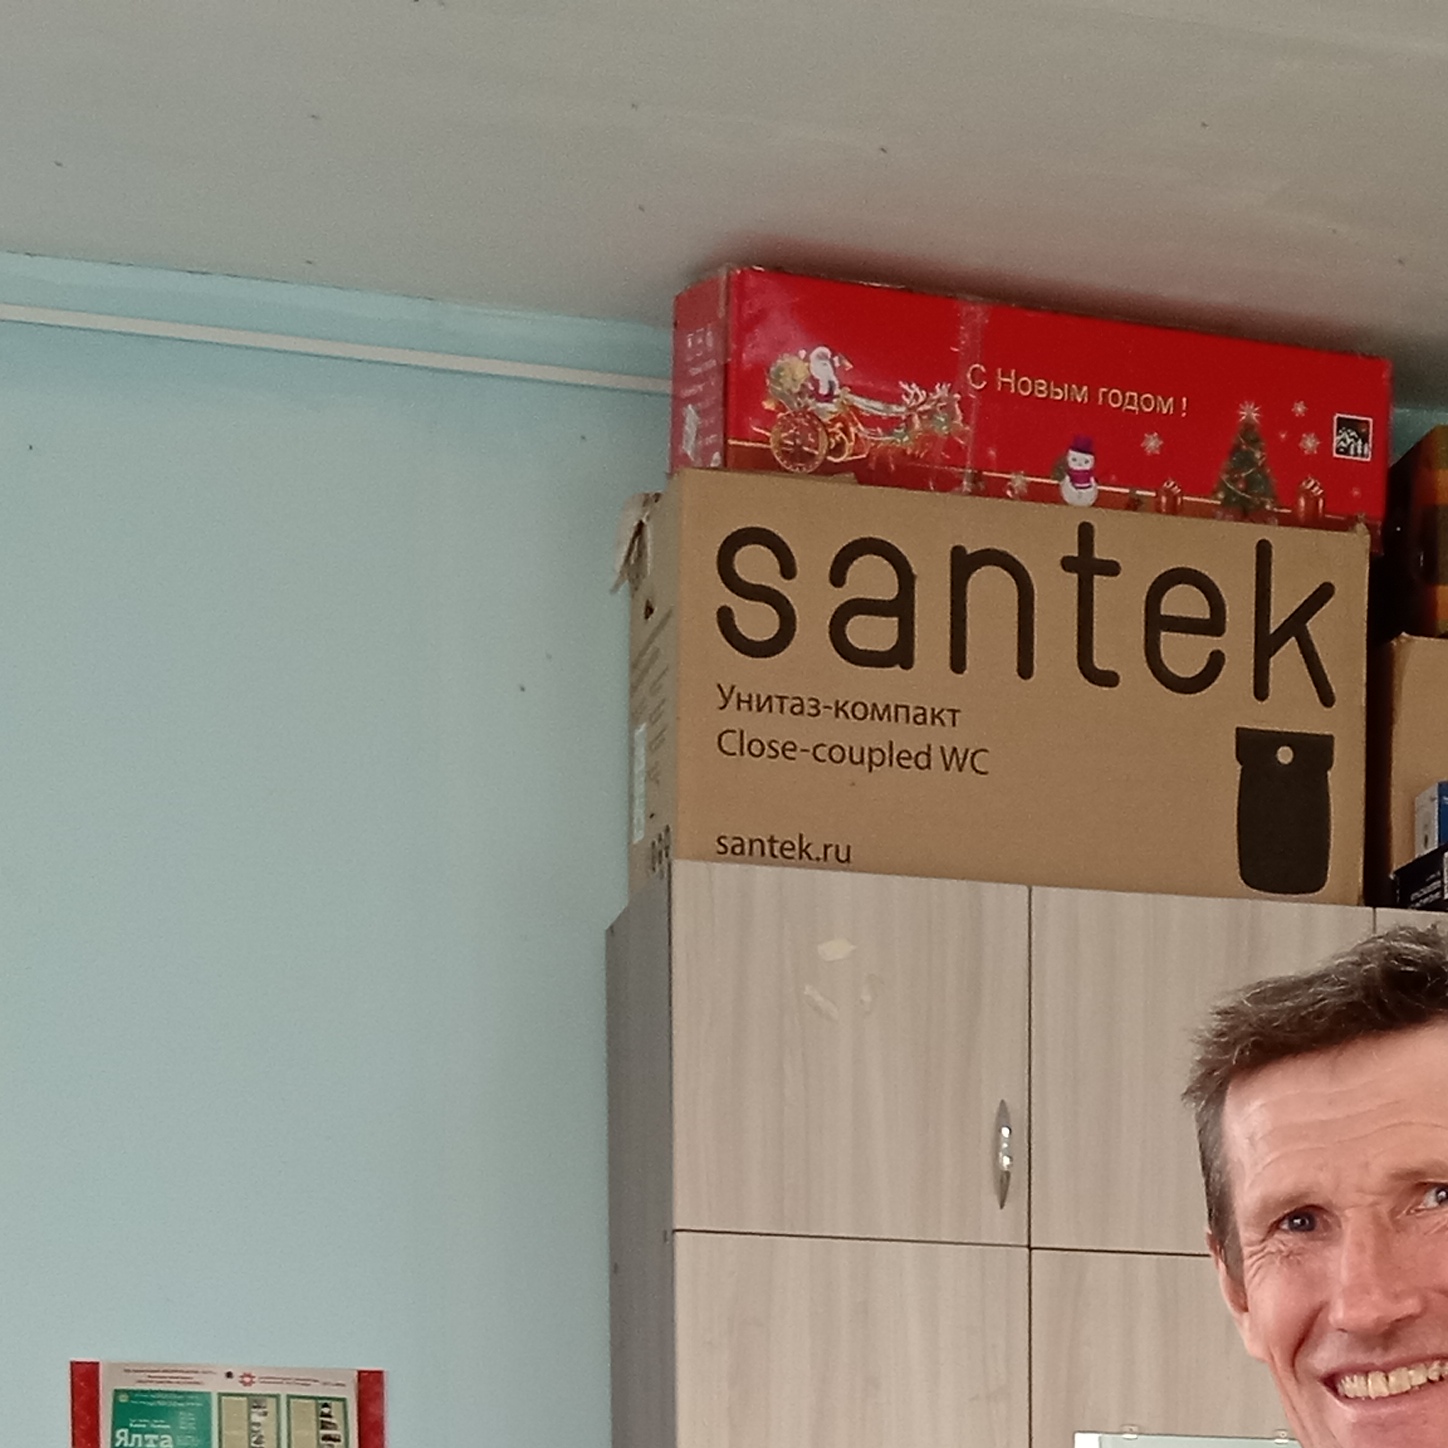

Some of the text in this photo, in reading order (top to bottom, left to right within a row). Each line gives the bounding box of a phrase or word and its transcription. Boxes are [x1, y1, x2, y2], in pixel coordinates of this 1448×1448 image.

[995, 368, 1090, 405] Новым
[715, 521, 1337, 709] santek
[716, 682, 962, 729] Унитаз-компакт
[716, 728, 991, 776] Close-coupled WC
[715, 829, 853, 865] santek.ru
[115, 1428, 174, 1448] Ялта
